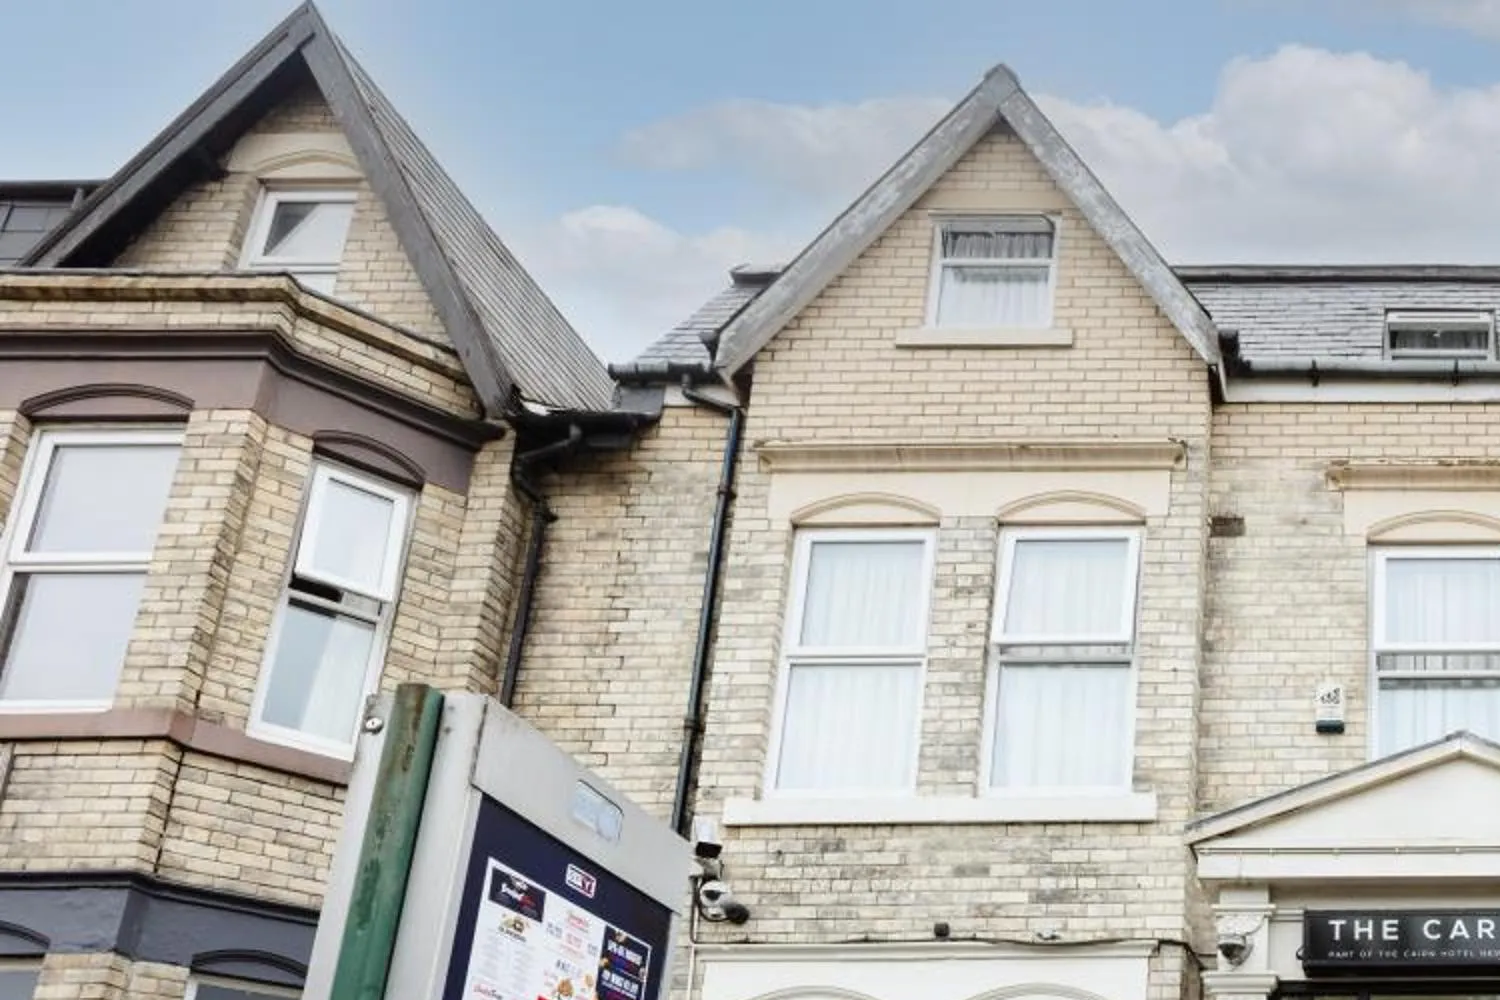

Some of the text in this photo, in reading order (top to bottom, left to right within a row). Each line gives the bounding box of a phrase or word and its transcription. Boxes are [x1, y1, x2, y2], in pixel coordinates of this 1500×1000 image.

[1328, 918, 1399, 941] THE
[1359, 949, 1372, 958] OF
[1441, 949, 1474, 958] HOTEL
